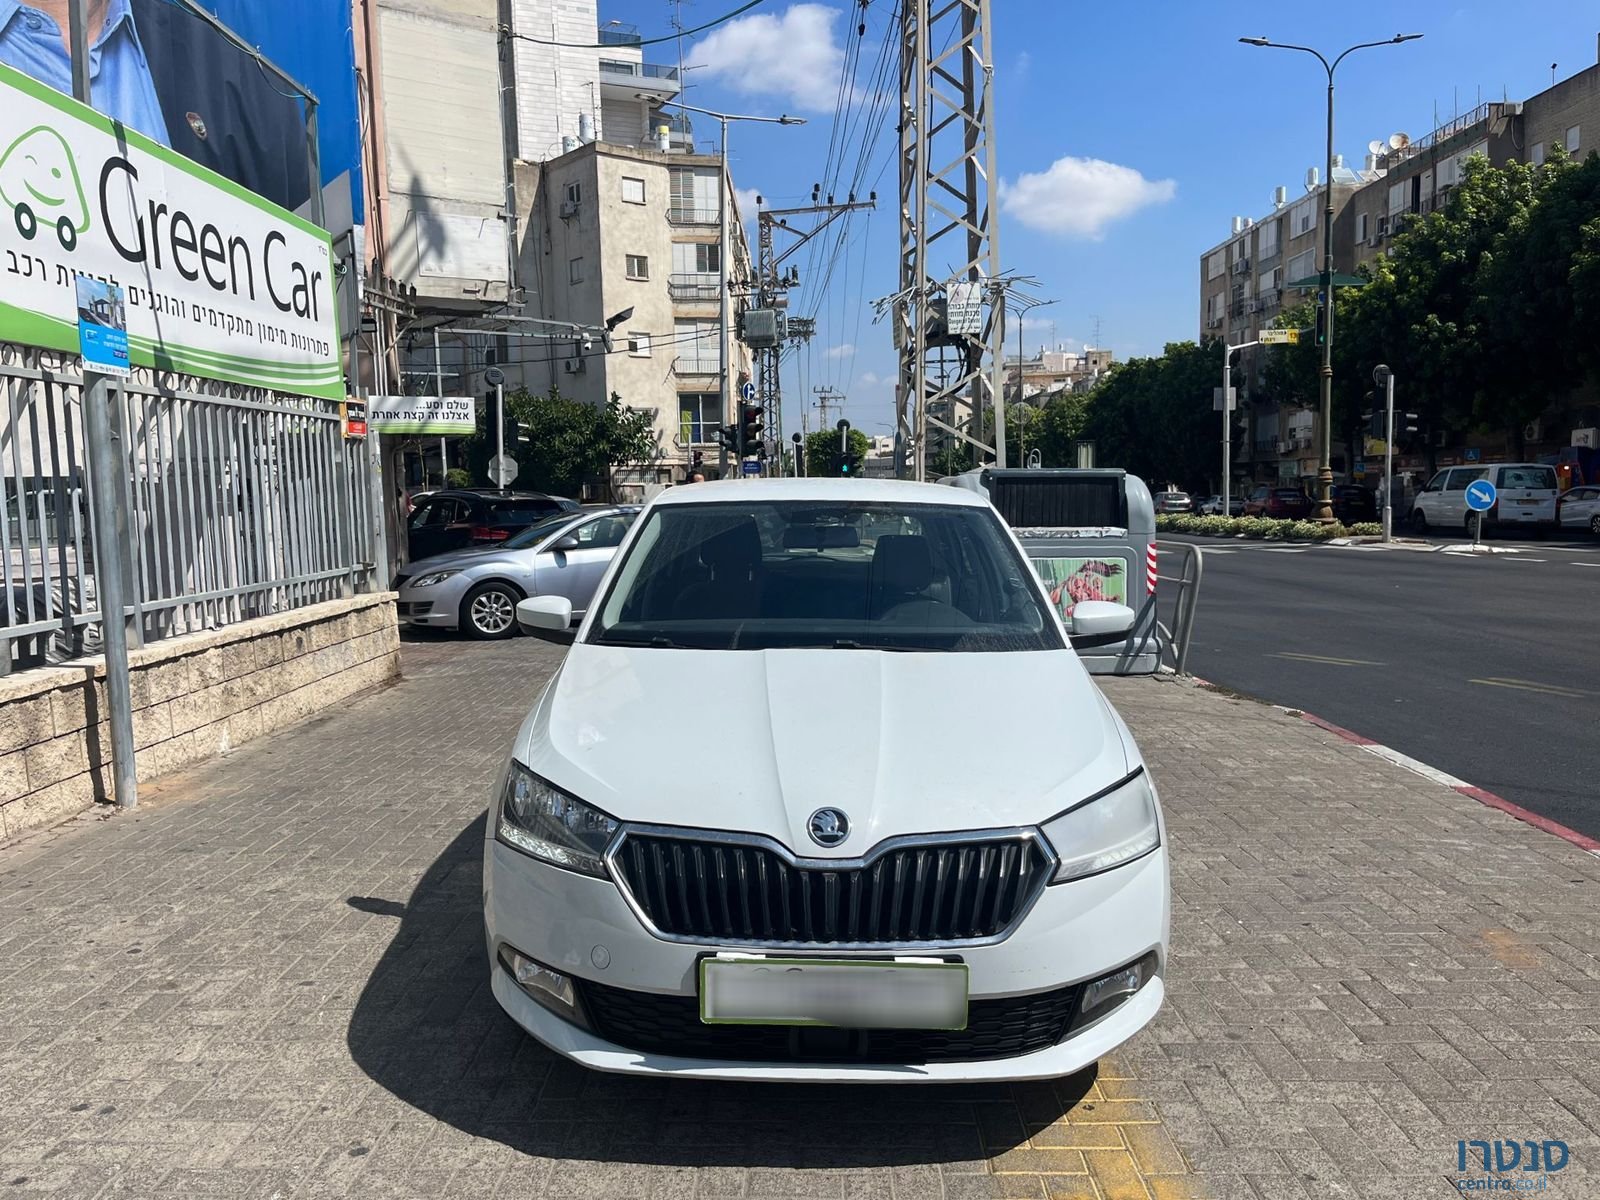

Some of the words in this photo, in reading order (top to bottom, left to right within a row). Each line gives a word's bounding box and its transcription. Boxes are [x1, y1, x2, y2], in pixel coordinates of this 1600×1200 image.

[99, 156, 256, 301] Green
[263, 230, 322, 322] Car
[6, 249, 47, 281] רכב
[128, 285, 186, 318] והוגנים
[192, 304, 253, 336] מתקדמים
[257, 322, 287, 344] מימון
[290, 332, 329, 357] פתרונות
[371, 411, 400, 420] אחרת
[428, 411, 440, 420] זה
[441, 411, 469, 420] אצלנו
[446, 400, 469, 409] שלם
[403, 411, 425, 421] קצת
